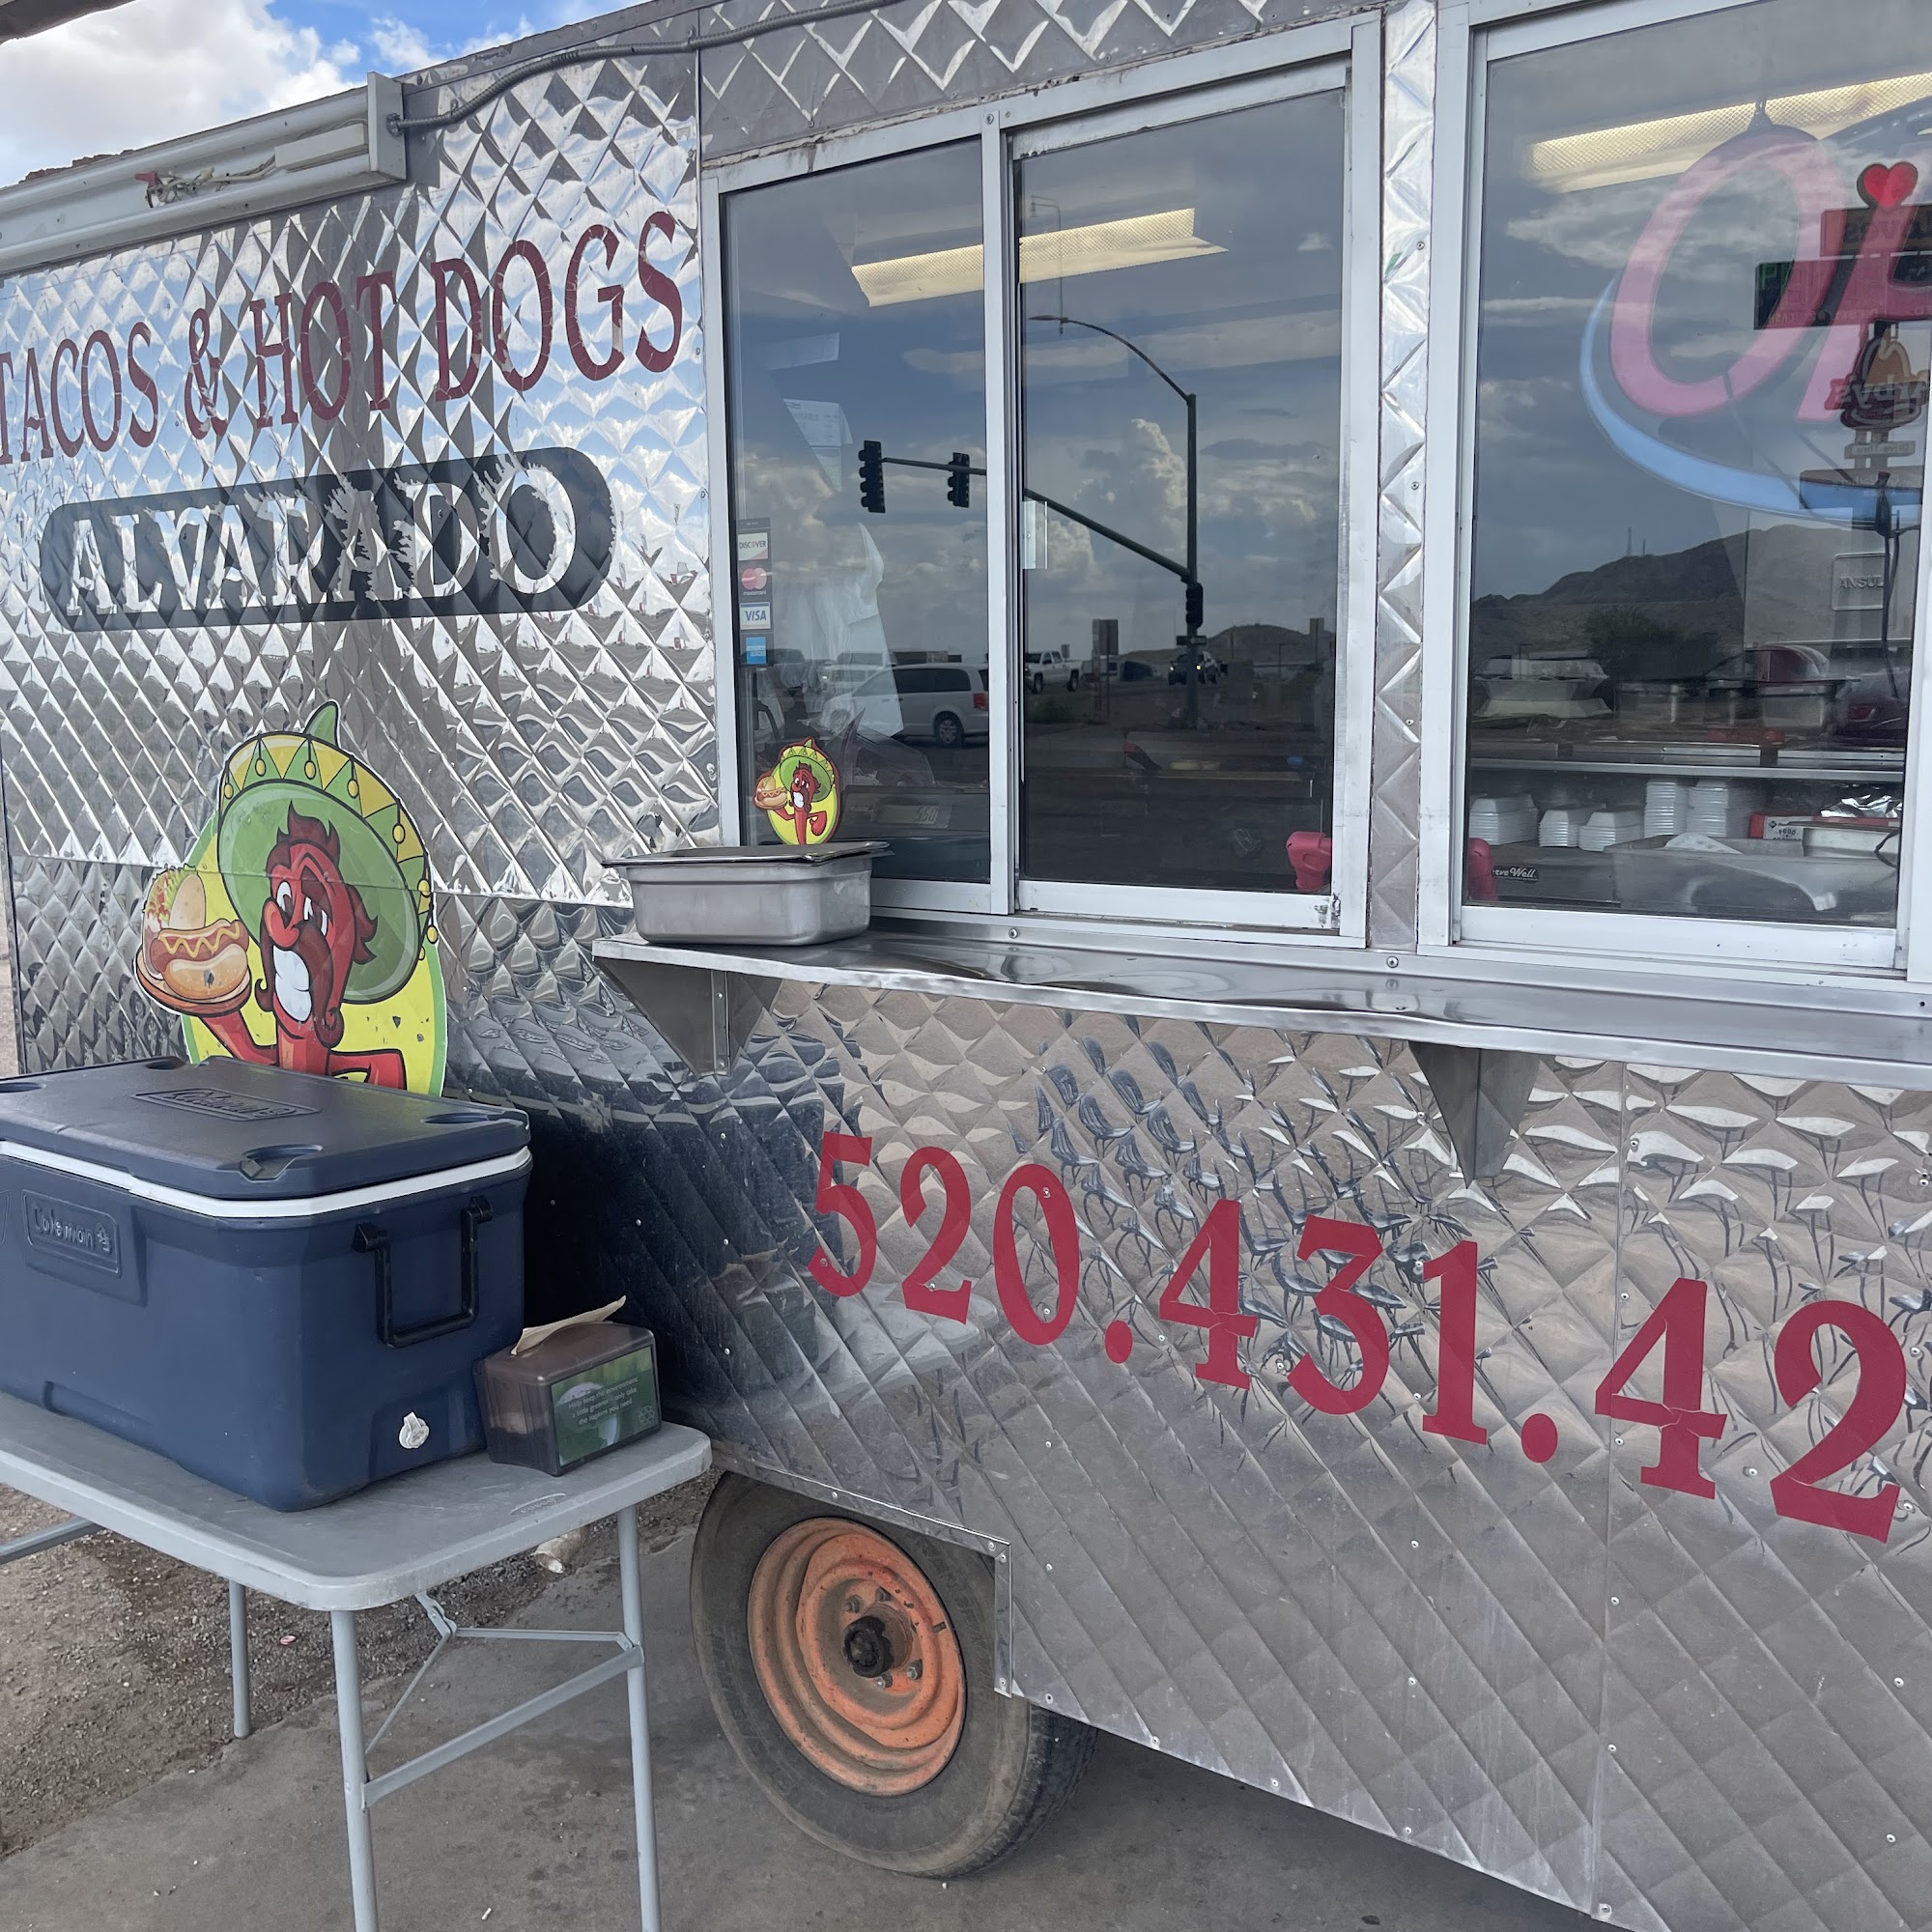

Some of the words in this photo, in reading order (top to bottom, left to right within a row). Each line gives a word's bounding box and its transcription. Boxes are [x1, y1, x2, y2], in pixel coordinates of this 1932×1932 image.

[0, 322, 157, 465] TACOS
[185, 308, 229, 440] &
[250, 270, 398, 428] HOT
[430, 211, 683, 402] DOGS
[67, 468, 577, 616] ALVARADO
[739, 540, 767, 549] DISCOVER
[1839, 575, 1885, 588] ANSUL
[745, 610, 767, 621] VISA
[1509, 867, 1536, 878] Well
[33, 1204, 96, 1251] Coleman
[809, 1131, 1906, 1545] 520.431.42
[568, 1401, 582, 1409] Help
[582, 1394, 596, 1405] keep
[596, 1389, 606, 1399] the
[606, 1378, 639, 1394] environment
[576, 1406, 589, 1417] little
[589, 1399, 610, 1413] greener
[613, 1391, 626, 1401] only
[625, 1386, 638, 1396] take
[578, 1417, 588, 1426] the
[588, 1408, 609, 1421] napkins
[609, 1404, 619, 1413] you
[619, 1397, 634, 1408] need
